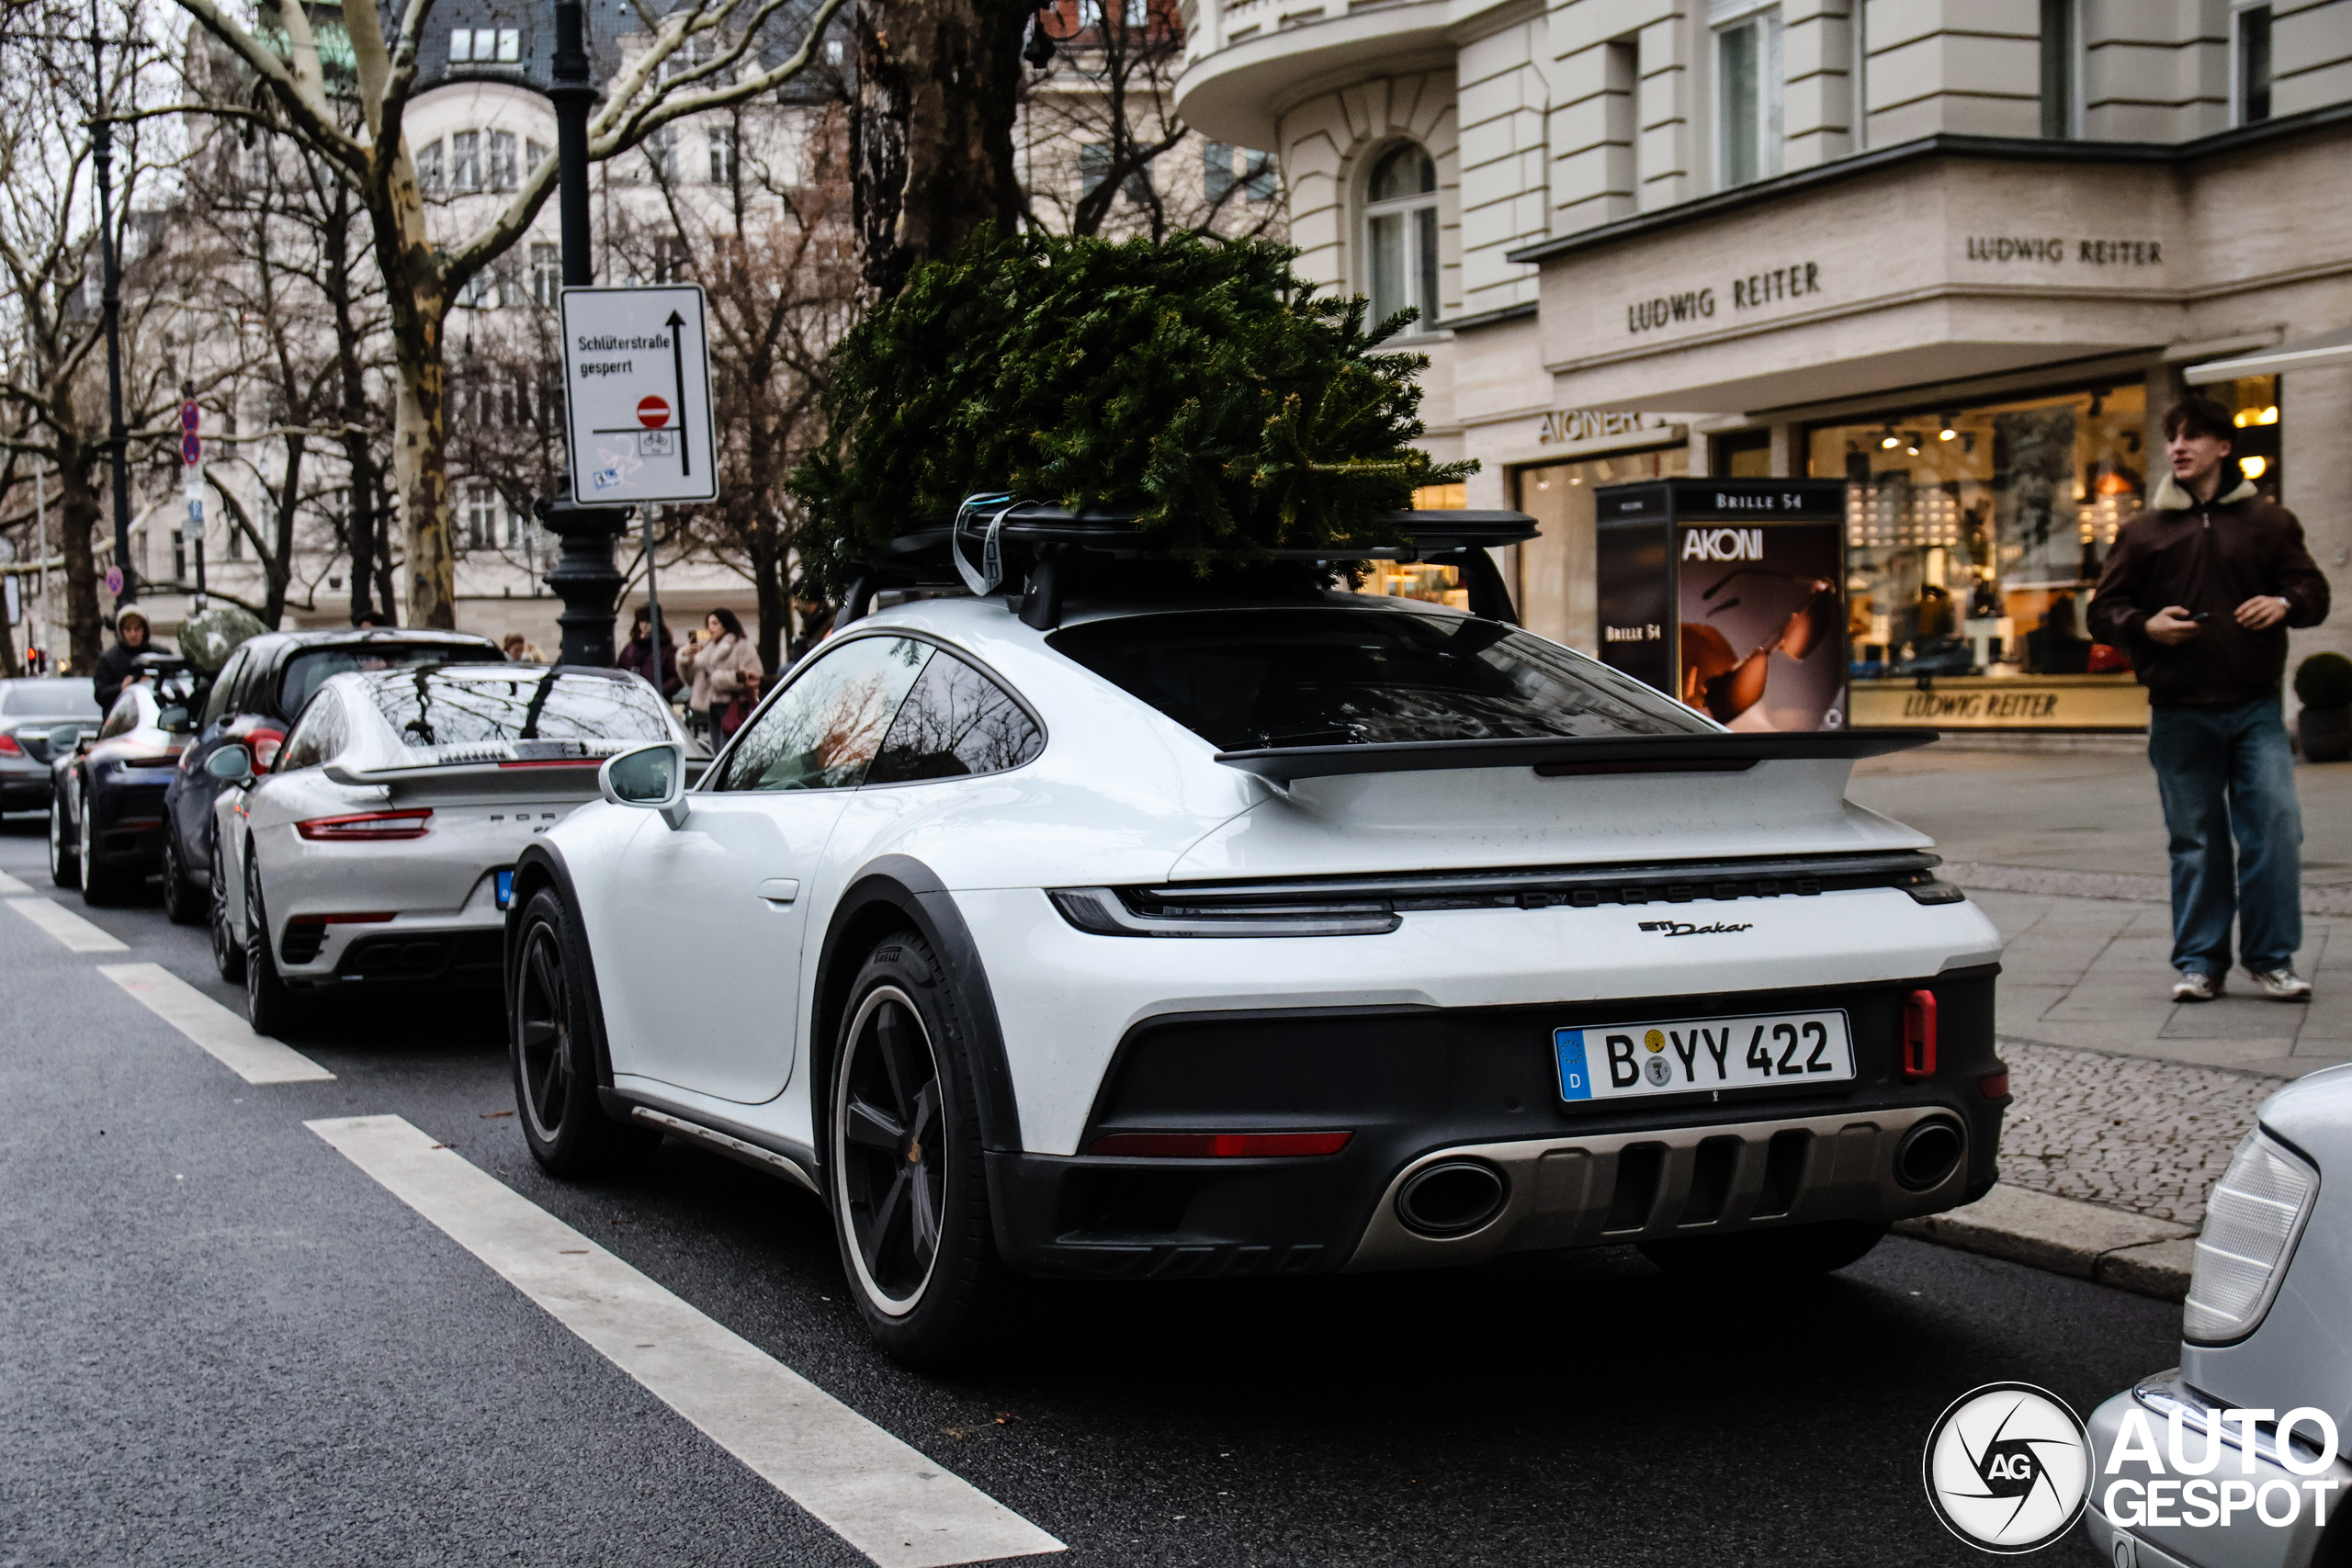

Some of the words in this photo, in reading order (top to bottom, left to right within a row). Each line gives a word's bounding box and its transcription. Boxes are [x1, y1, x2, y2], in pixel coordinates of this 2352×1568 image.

[1967, 235, 2064, 263] LUDWIG
[2080, 239, 2163, 266] REITER
[1627, 287, 1716, 333] LUDWIG
[1734, 260, 1821, 310] REITER
[578, 333, 671, 351] Schlüterstraße
[580, 358, 633, 378] gesperrt
[1540, 411, 1644, 446] AIGNER
[1781, 492, 1803, 509] 54
[1681, 527, 1764, 561] AKONI
[1645, 624, 1661, 641] 54
[1904, 693, 1982, 718] LUDWIG
[1986, 693, 2058, 717] REITER
[1519, 878, 1823, 910] PORSCHE
[1663, 920, 1754, 937] Dakar
[874, 946, 903, 964] PIRELLI
[1605, 1034, 1640, 1089] B
[1669, 1026, 1730, 1083] YY
[1746, 1021, 1833, 1077] 422
[1569, 1072, 1582, 1089] D
